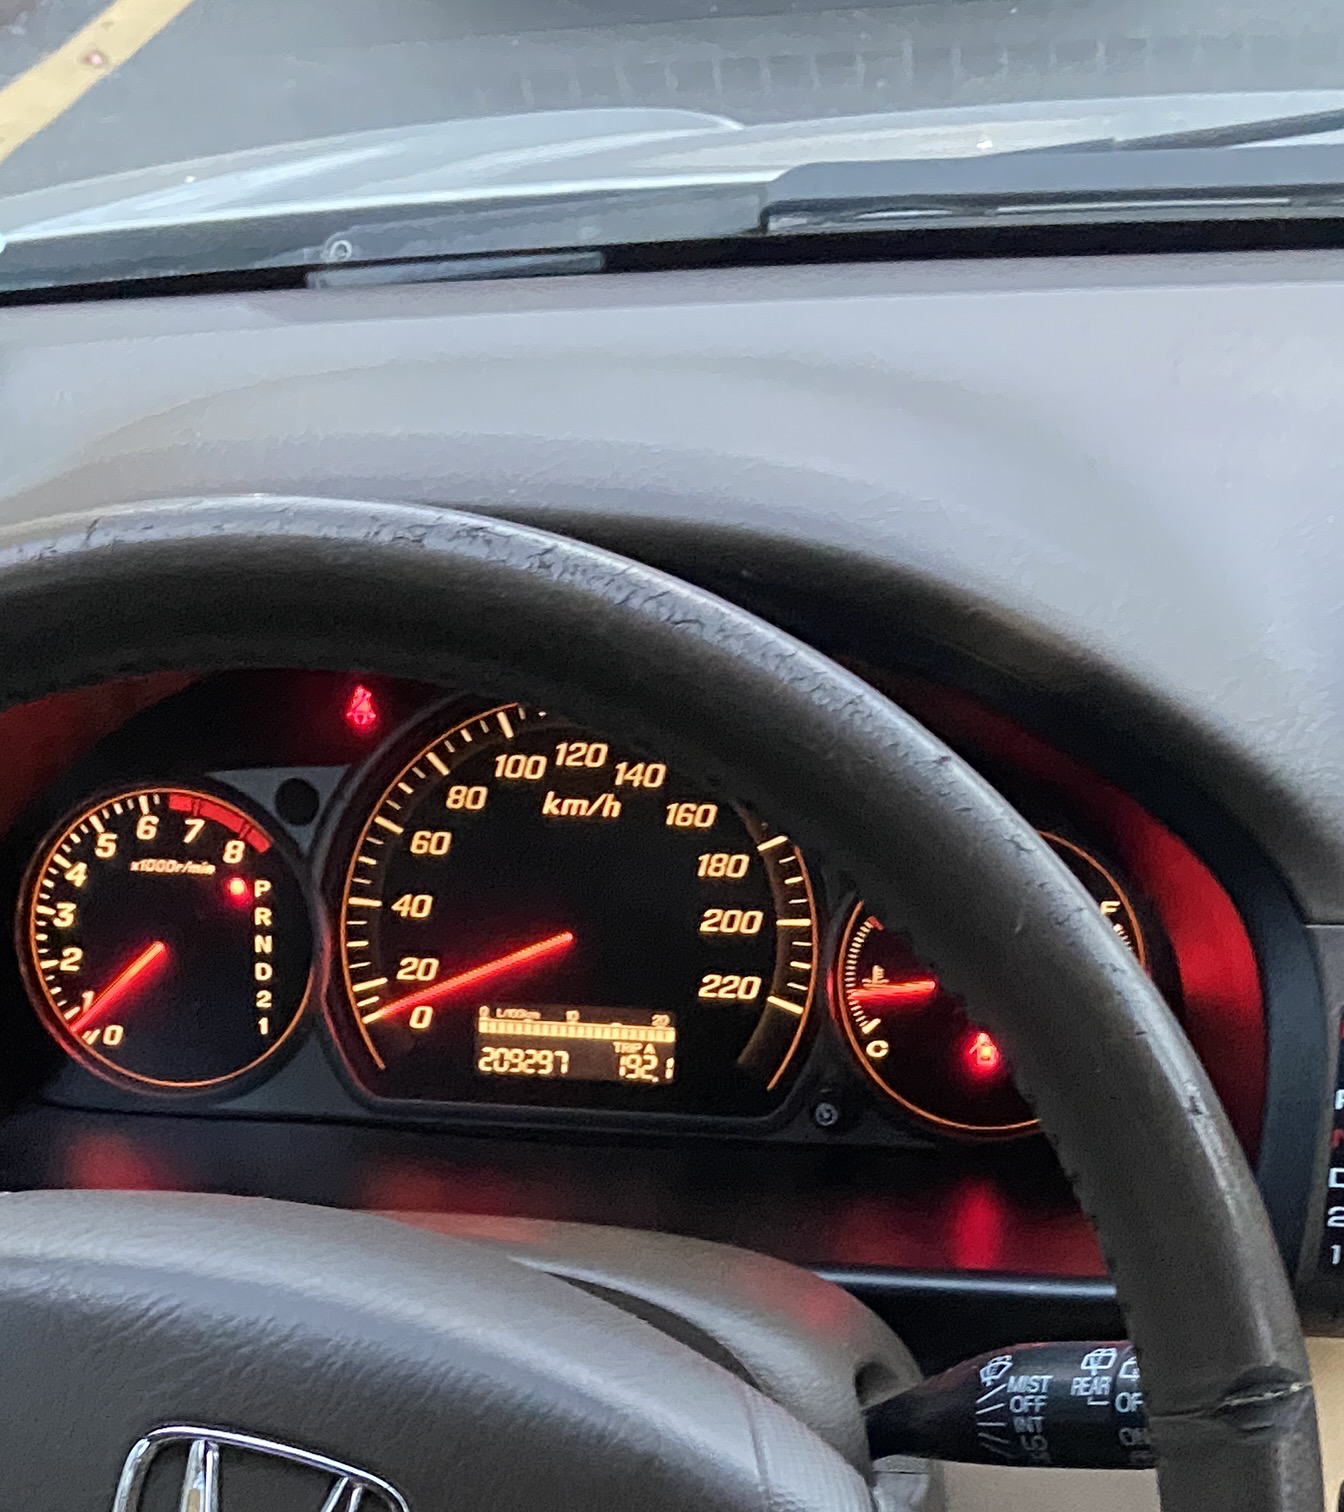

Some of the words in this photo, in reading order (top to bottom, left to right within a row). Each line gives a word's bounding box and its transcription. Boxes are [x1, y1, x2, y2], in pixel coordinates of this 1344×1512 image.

[555, 741, 609, 768] 120
[494, 754, 547, 780] 100
[614, 762, 667, 788] 140
[446, 786, 488, 810] 80
[542, 791, 622, 818] km/h
[136, 815, 159, 840] 6
[665, 803, 718, 829] 160
[183, 819, 205, 844] 7
[410, 831, 452, 856] 60
[95, 833, 118, 858] 5
[223, 840, 246, 864] 8
[64, 862, 87, 887] 4
[697, 853, 750, 879] 180
[254, 879, 272, 898] P
[53, 902, 76, 927] 3
[254, 907, 272, 926] R
[392, 894, 433, 918] 40
[699, 909, 764, 934] 200
[254, 935, 273, 953] N
[60, 947, 83, 972] 2
[254, 962, 273, 981] D
[397, 957, 439, 982] 20
[255, 990, 272, 1009] 2
[698, 975, 762, 1000] 220
[258, 1017, 270, 1035] 1
[408, 1005, 433, 1029] 0
[102, 1025, 124, 1046] 0
[612, 1041, 644, 1054] TRIP
[643, 1043, 656, 1055] A
[478, 1046, 570, 1075] 209297
[1330, 1244, 1342, 1265] 1
[1006, 1374, 1054, 1393] MIST
[1069, 1376, 1112, 1396] REAR
[1009, 1395, 1048, 1413] OFF
[1115, 1392, 1144, 1413] OF
